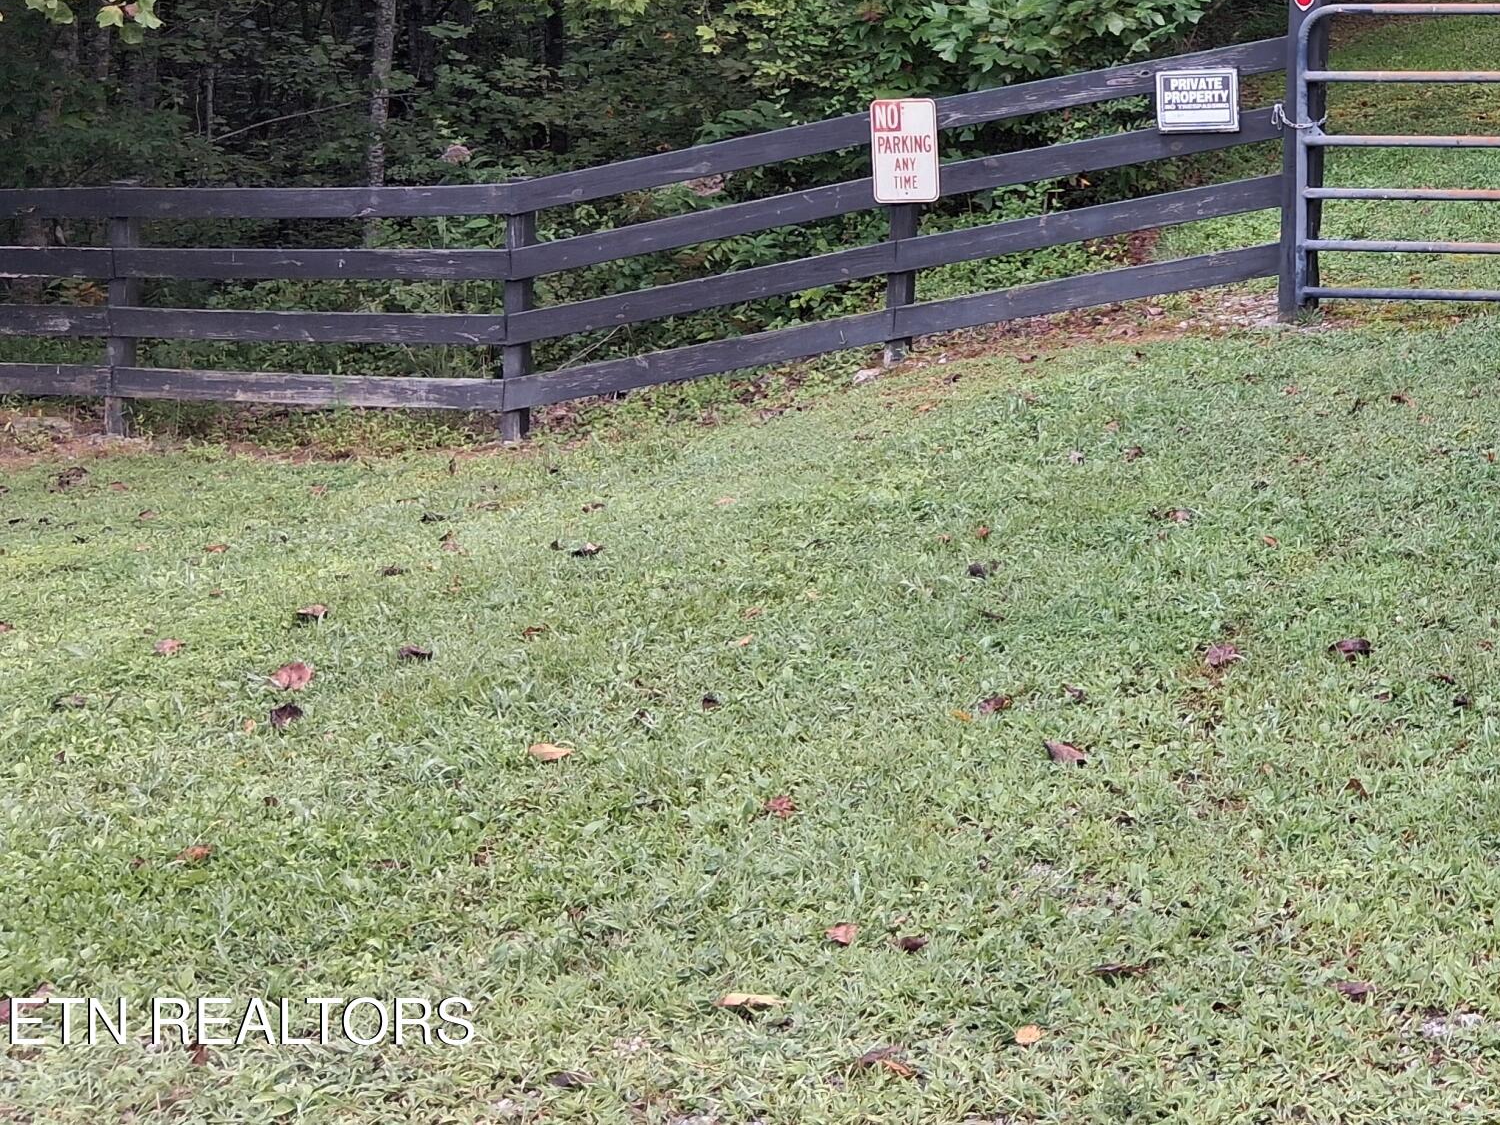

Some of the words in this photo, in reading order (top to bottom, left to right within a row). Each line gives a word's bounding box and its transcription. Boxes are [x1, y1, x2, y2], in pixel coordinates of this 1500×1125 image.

[1170, 77, 1223, 91] PRIVATE
[1164, 90, 1229, 104] PROPERTY
[875, 104, 899, 129] NO
[877, 135, 932, 154] PARKING
[894, 157, 917, 172] ANY
[894, 175, 918, 190] TIME
